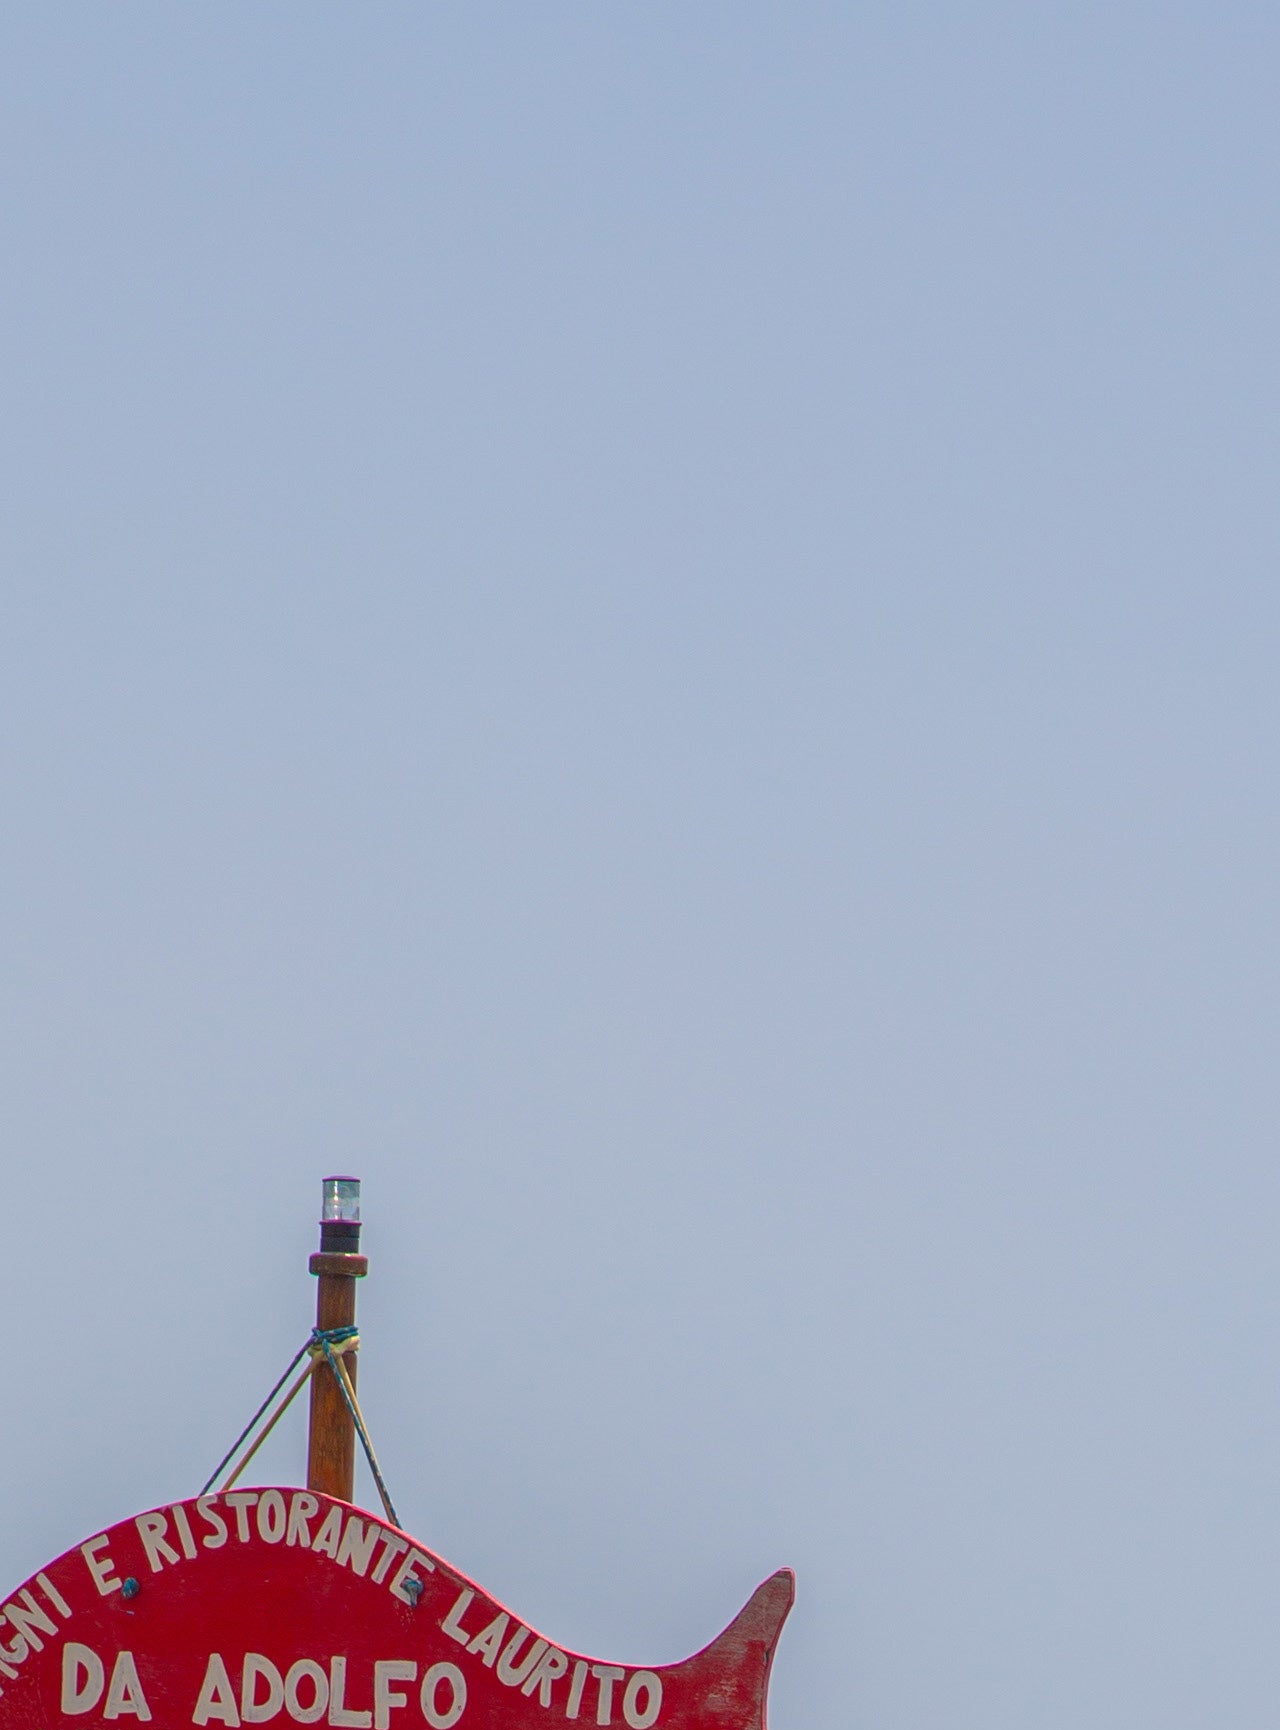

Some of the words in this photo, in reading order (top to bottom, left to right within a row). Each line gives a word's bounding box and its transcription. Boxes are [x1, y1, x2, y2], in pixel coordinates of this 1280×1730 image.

[60, 1643, 152, 1722] DA
[191, 1653, 467, 1730] ADOLFO
[80, 1533, 123, 1596] E
[134, 1489, 437, 1606] RISTORANTE
[441, 1588, 663, 1730] LAURITO
